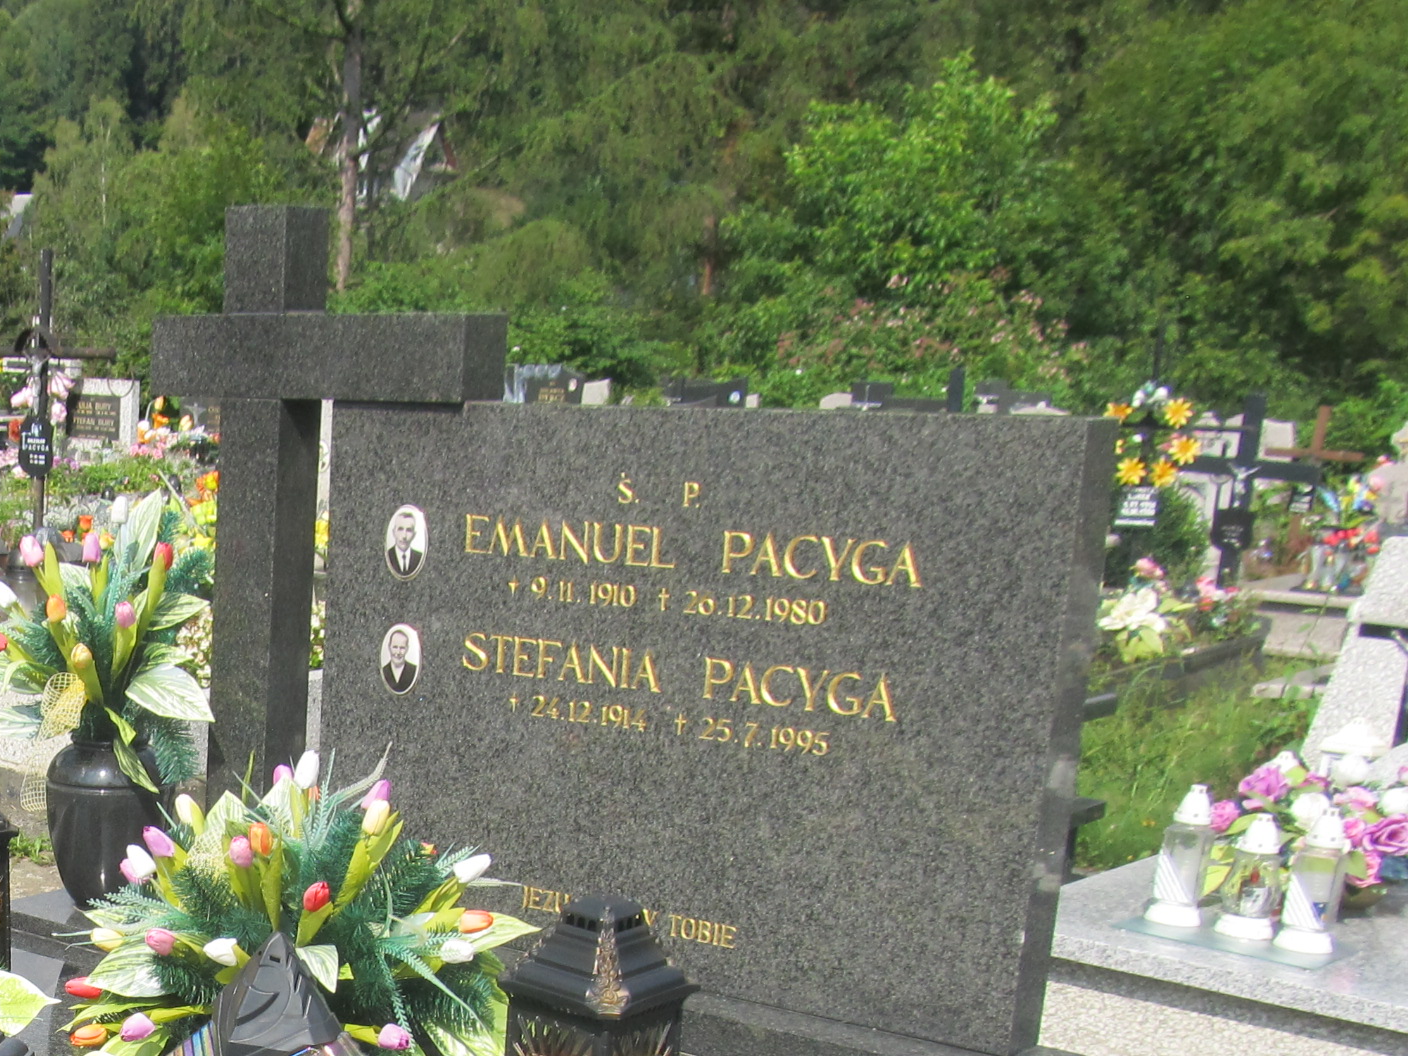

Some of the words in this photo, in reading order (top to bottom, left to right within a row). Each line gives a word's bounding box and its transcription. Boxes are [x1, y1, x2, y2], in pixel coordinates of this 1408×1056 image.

[464, 514, 676, 569] EMANUEL
[721, 530, 923, 588] PACYGA
[462, 632, 662, 693] STEFANIA
[703, 657, 897, 722] PACYGA
[668, 912, 738, 949] TOBIE
